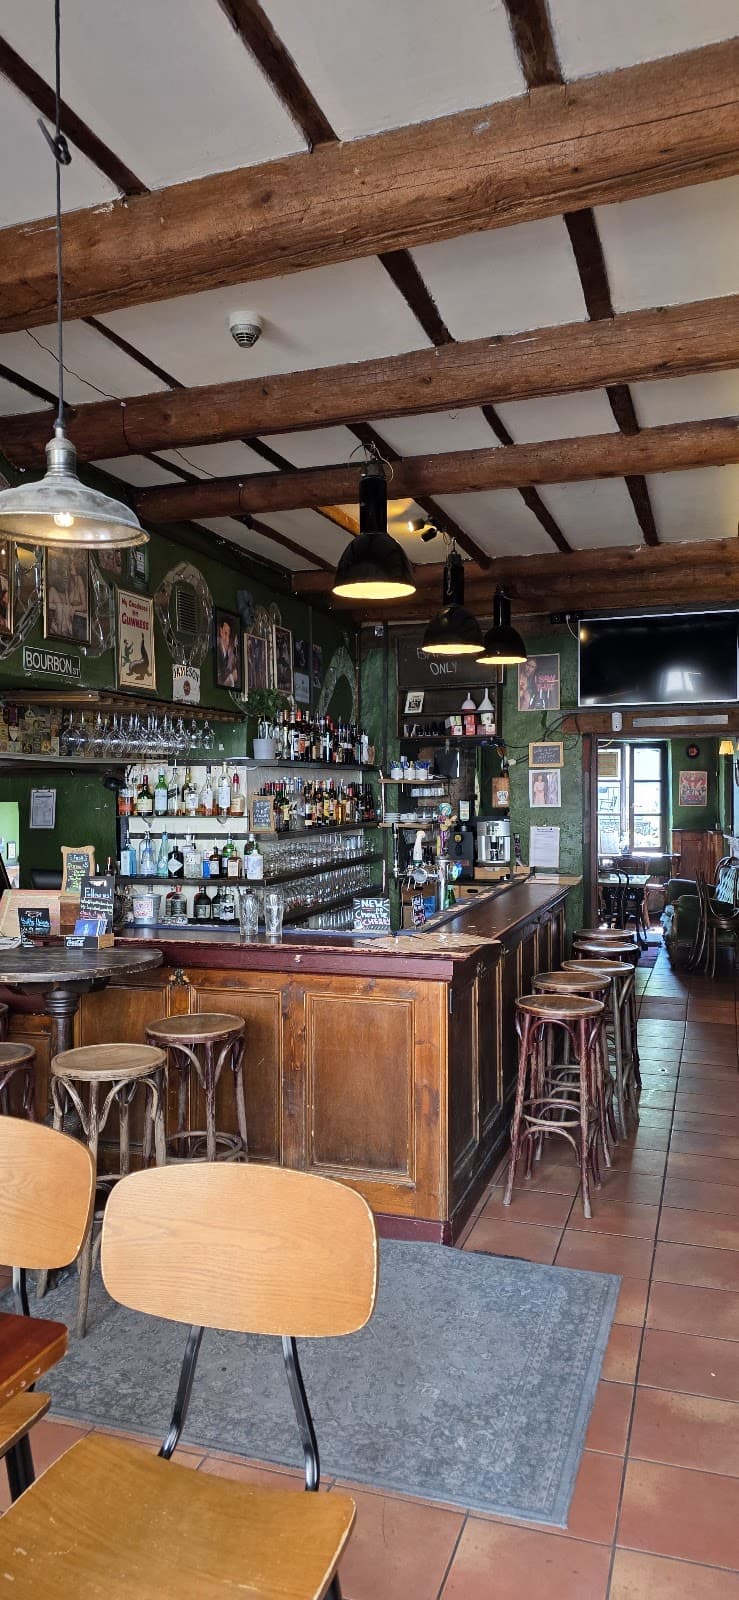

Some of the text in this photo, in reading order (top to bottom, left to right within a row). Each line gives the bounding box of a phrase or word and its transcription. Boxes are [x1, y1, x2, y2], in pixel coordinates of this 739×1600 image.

[121, 612, 149, 631] GUINNESS
[25, 650, 80, 676] BOURBON ST
[430, 661, 457, 675] ONLY
[361, 899, 383, 908] NEW
